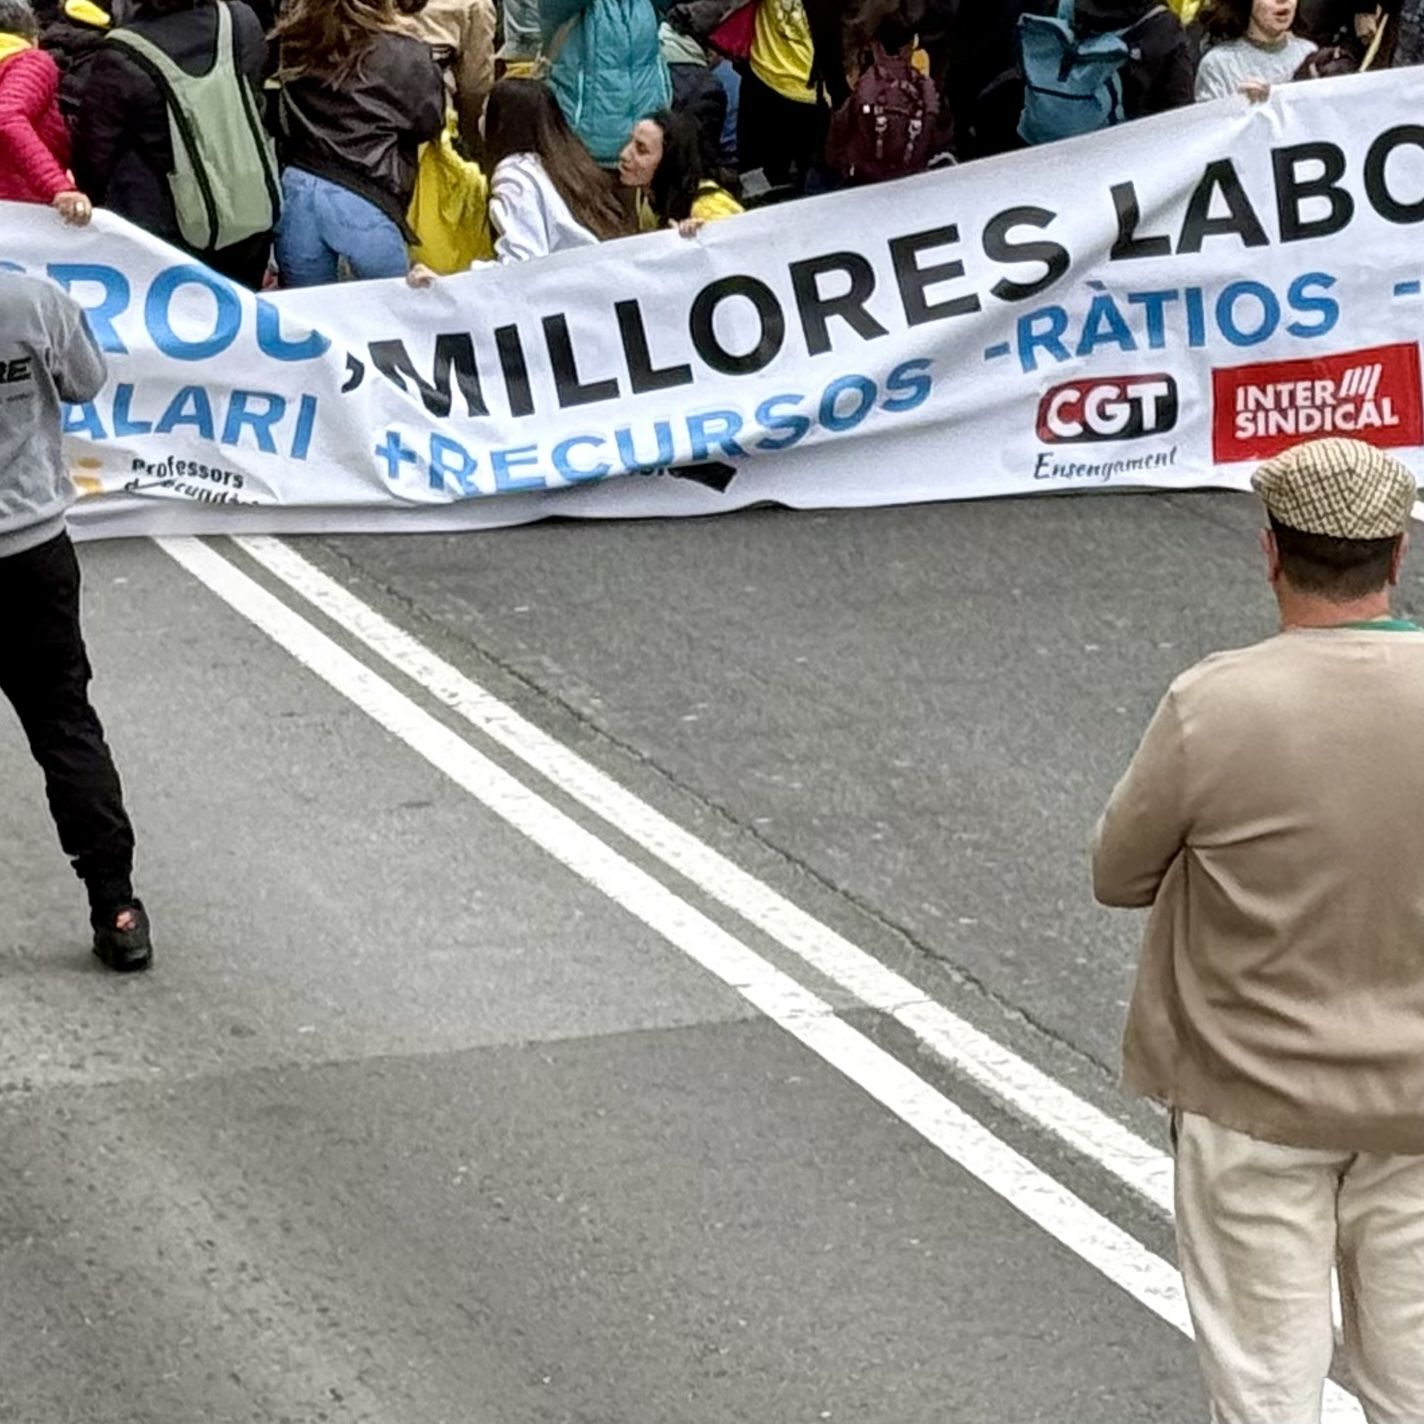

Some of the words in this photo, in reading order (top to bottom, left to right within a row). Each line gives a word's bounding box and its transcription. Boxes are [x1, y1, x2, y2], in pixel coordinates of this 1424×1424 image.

[368, 205, 1071, 418] MILLORES
[1045, 380, 1171, 438] CGT
[1235, 380, 1337, 411] INTER
[1235, 397, 1400, 440] SINDICAL
[131, 455, 244, 489] Professors
[1033, 445, 1179, 482] Ensenyament
